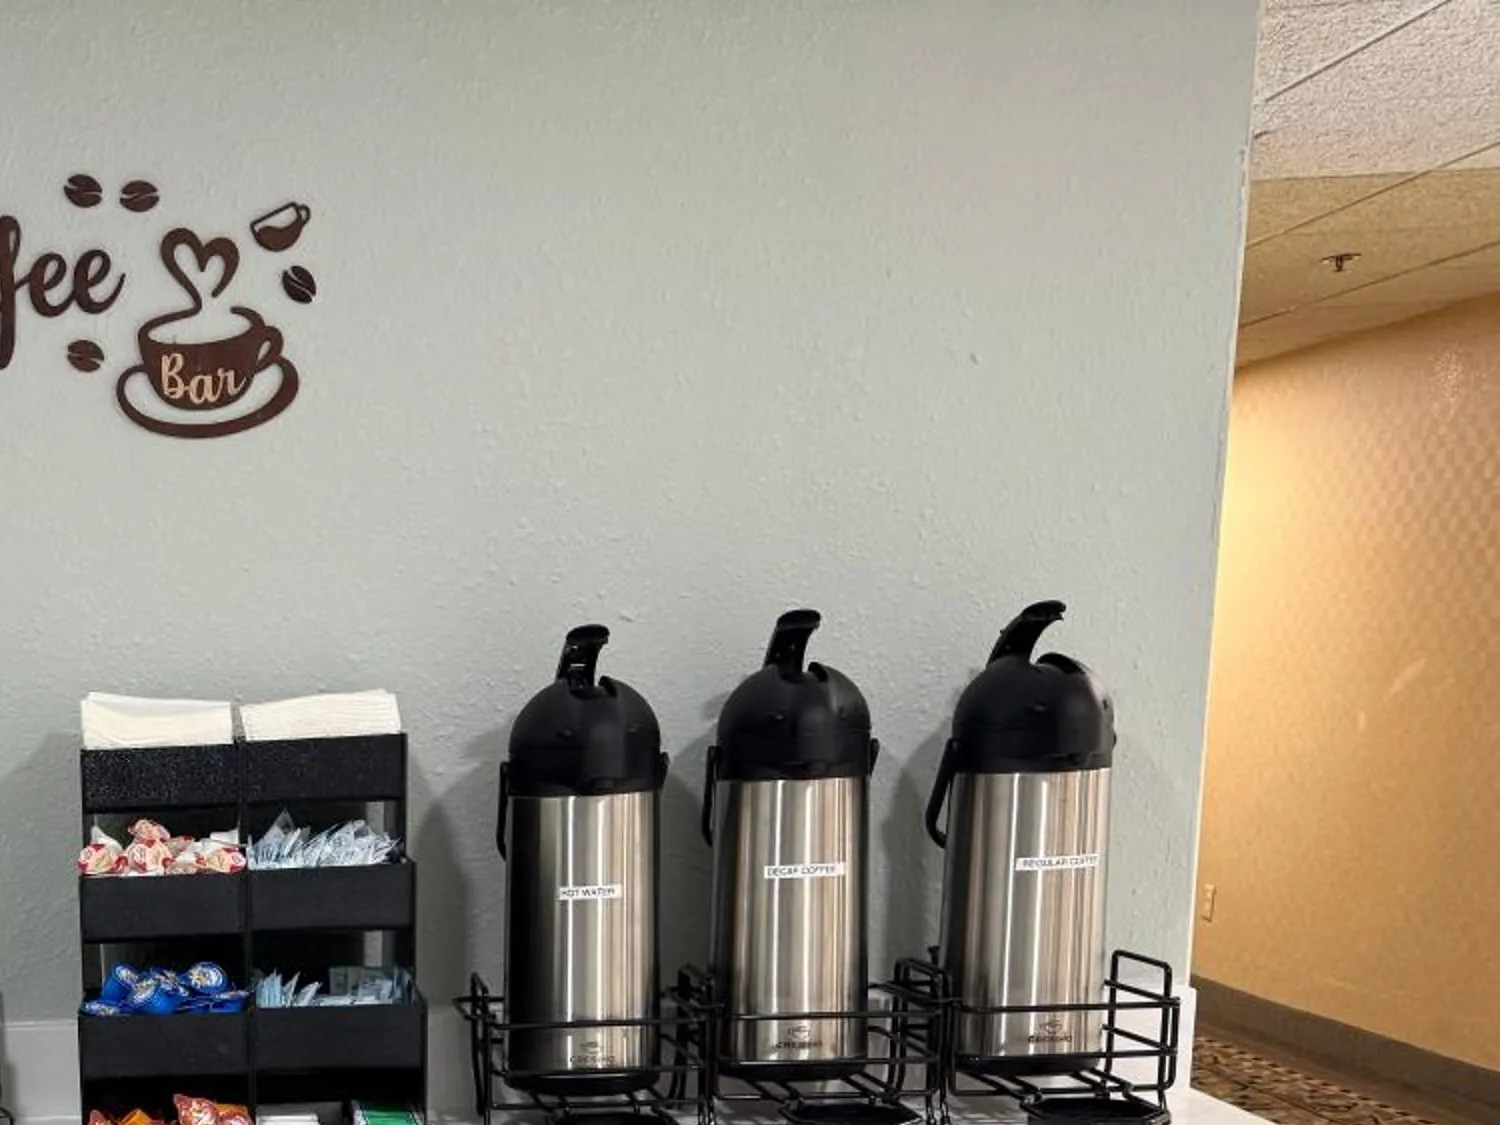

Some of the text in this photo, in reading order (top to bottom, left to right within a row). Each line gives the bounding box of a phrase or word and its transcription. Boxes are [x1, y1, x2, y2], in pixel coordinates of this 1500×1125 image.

[159, 352, 248, 406] Bar
[561, 887, 616, 898] HOT WATER
